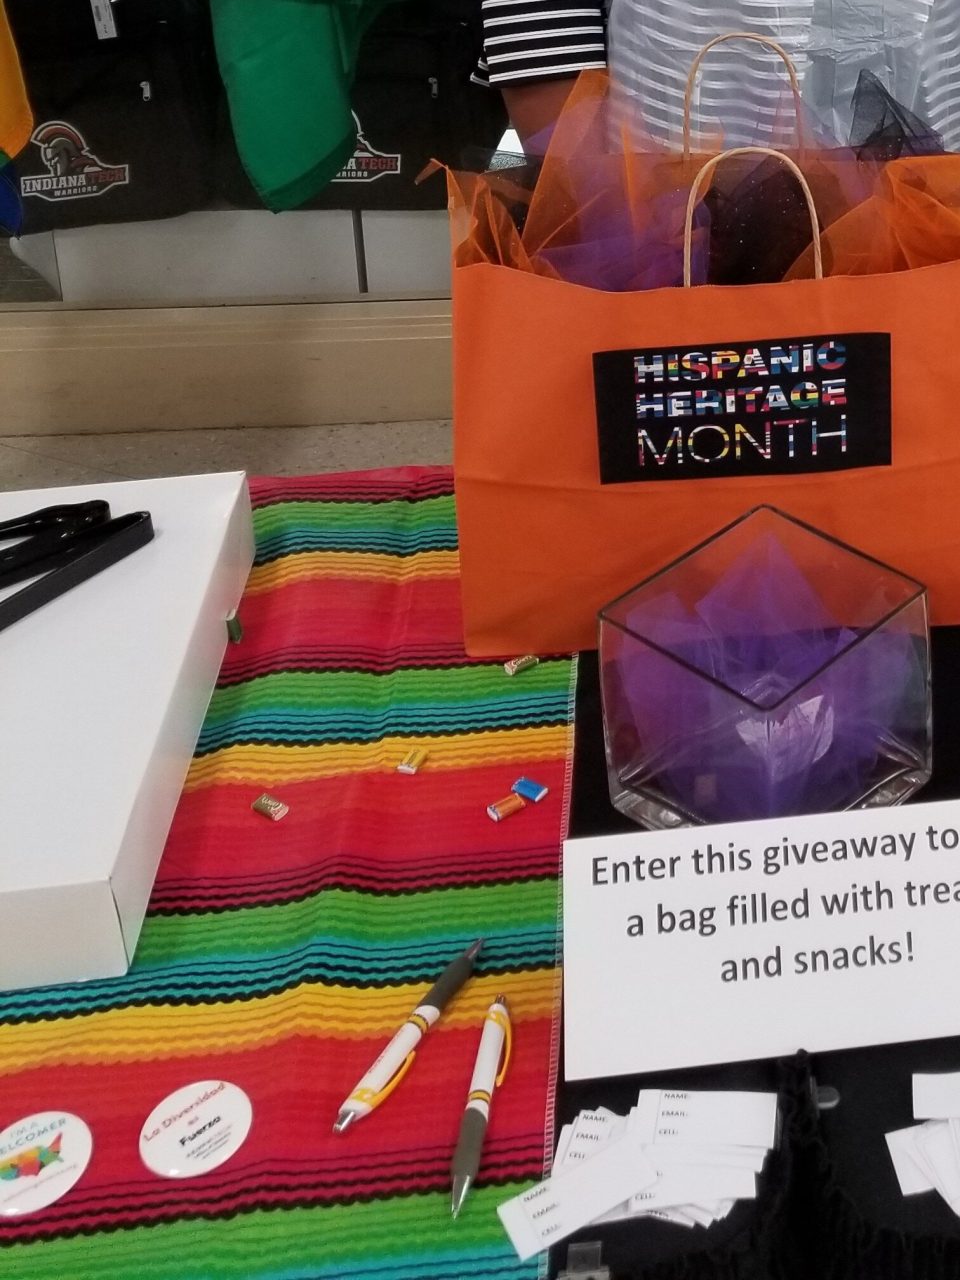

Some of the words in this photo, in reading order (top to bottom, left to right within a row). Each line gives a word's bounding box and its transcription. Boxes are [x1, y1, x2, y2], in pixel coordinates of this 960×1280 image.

[24, 174, 86, 192] INDIANA
[87, 168, 124, 185] TECH
[359, 157, 397, 170] TECH
[54, 185, 98, 197] WARRIORS
[633, 340, 847, 384] HISPANIC
[635, 378, 847, 419] HERITAGE
[637, 413, 847, 467] MONTH
[591, 852, 682, 886] Enter
[691, 842, 752, 876] this
[762, 830, 916, 876] giveaway
[926, 823, 960, 852] to
[626, 914, 645, 937] a
[657, 903, 717, 937] bag
[727, 888, 810, 927] filled
[820, 880, 894, 917] with
[720, 945, 782, 983] and
[793, 931, 915, 975] snacks!
[162, 1082, 226, 1128] Diversidad
[0, 1117, 67, 1156] ELCOMER
[179, 1115, 222, 1147] Fuerza
